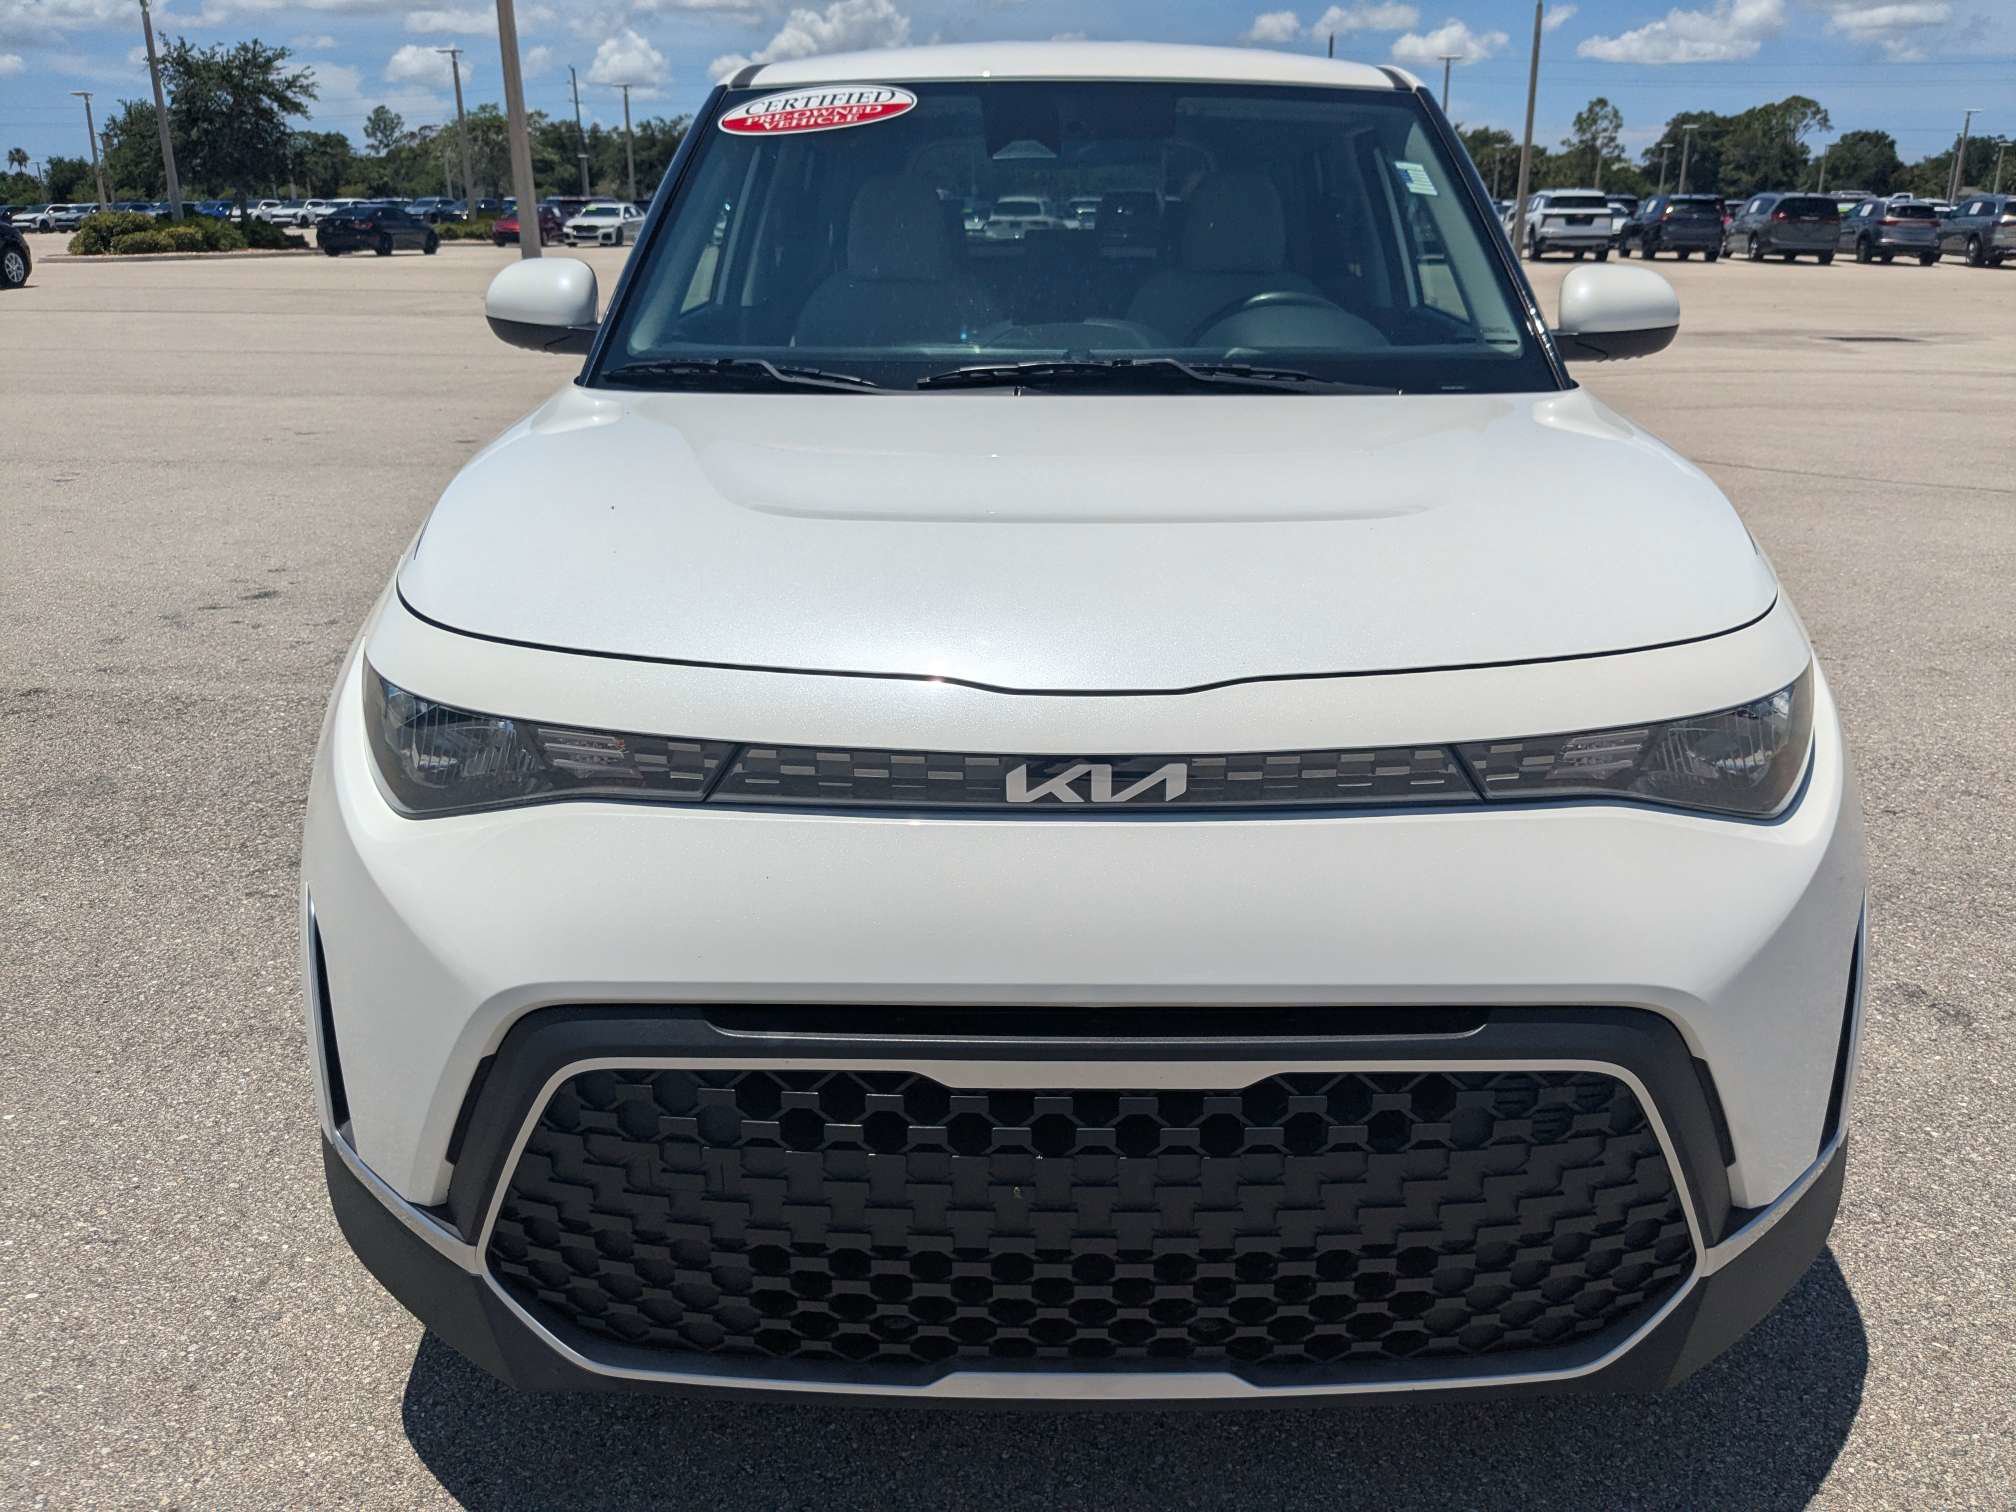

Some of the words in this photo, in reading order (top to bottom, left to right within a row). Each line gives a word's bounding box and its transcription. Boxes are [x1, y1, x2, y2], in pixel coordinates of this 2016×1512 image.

[746, 90, 895, 115] CERTIFIED
[744, 105, 882, 126] PRE-OWNED
[763, 114, 860, 131] VEHICLE
[1006, 764, 1187, 802] KIA
